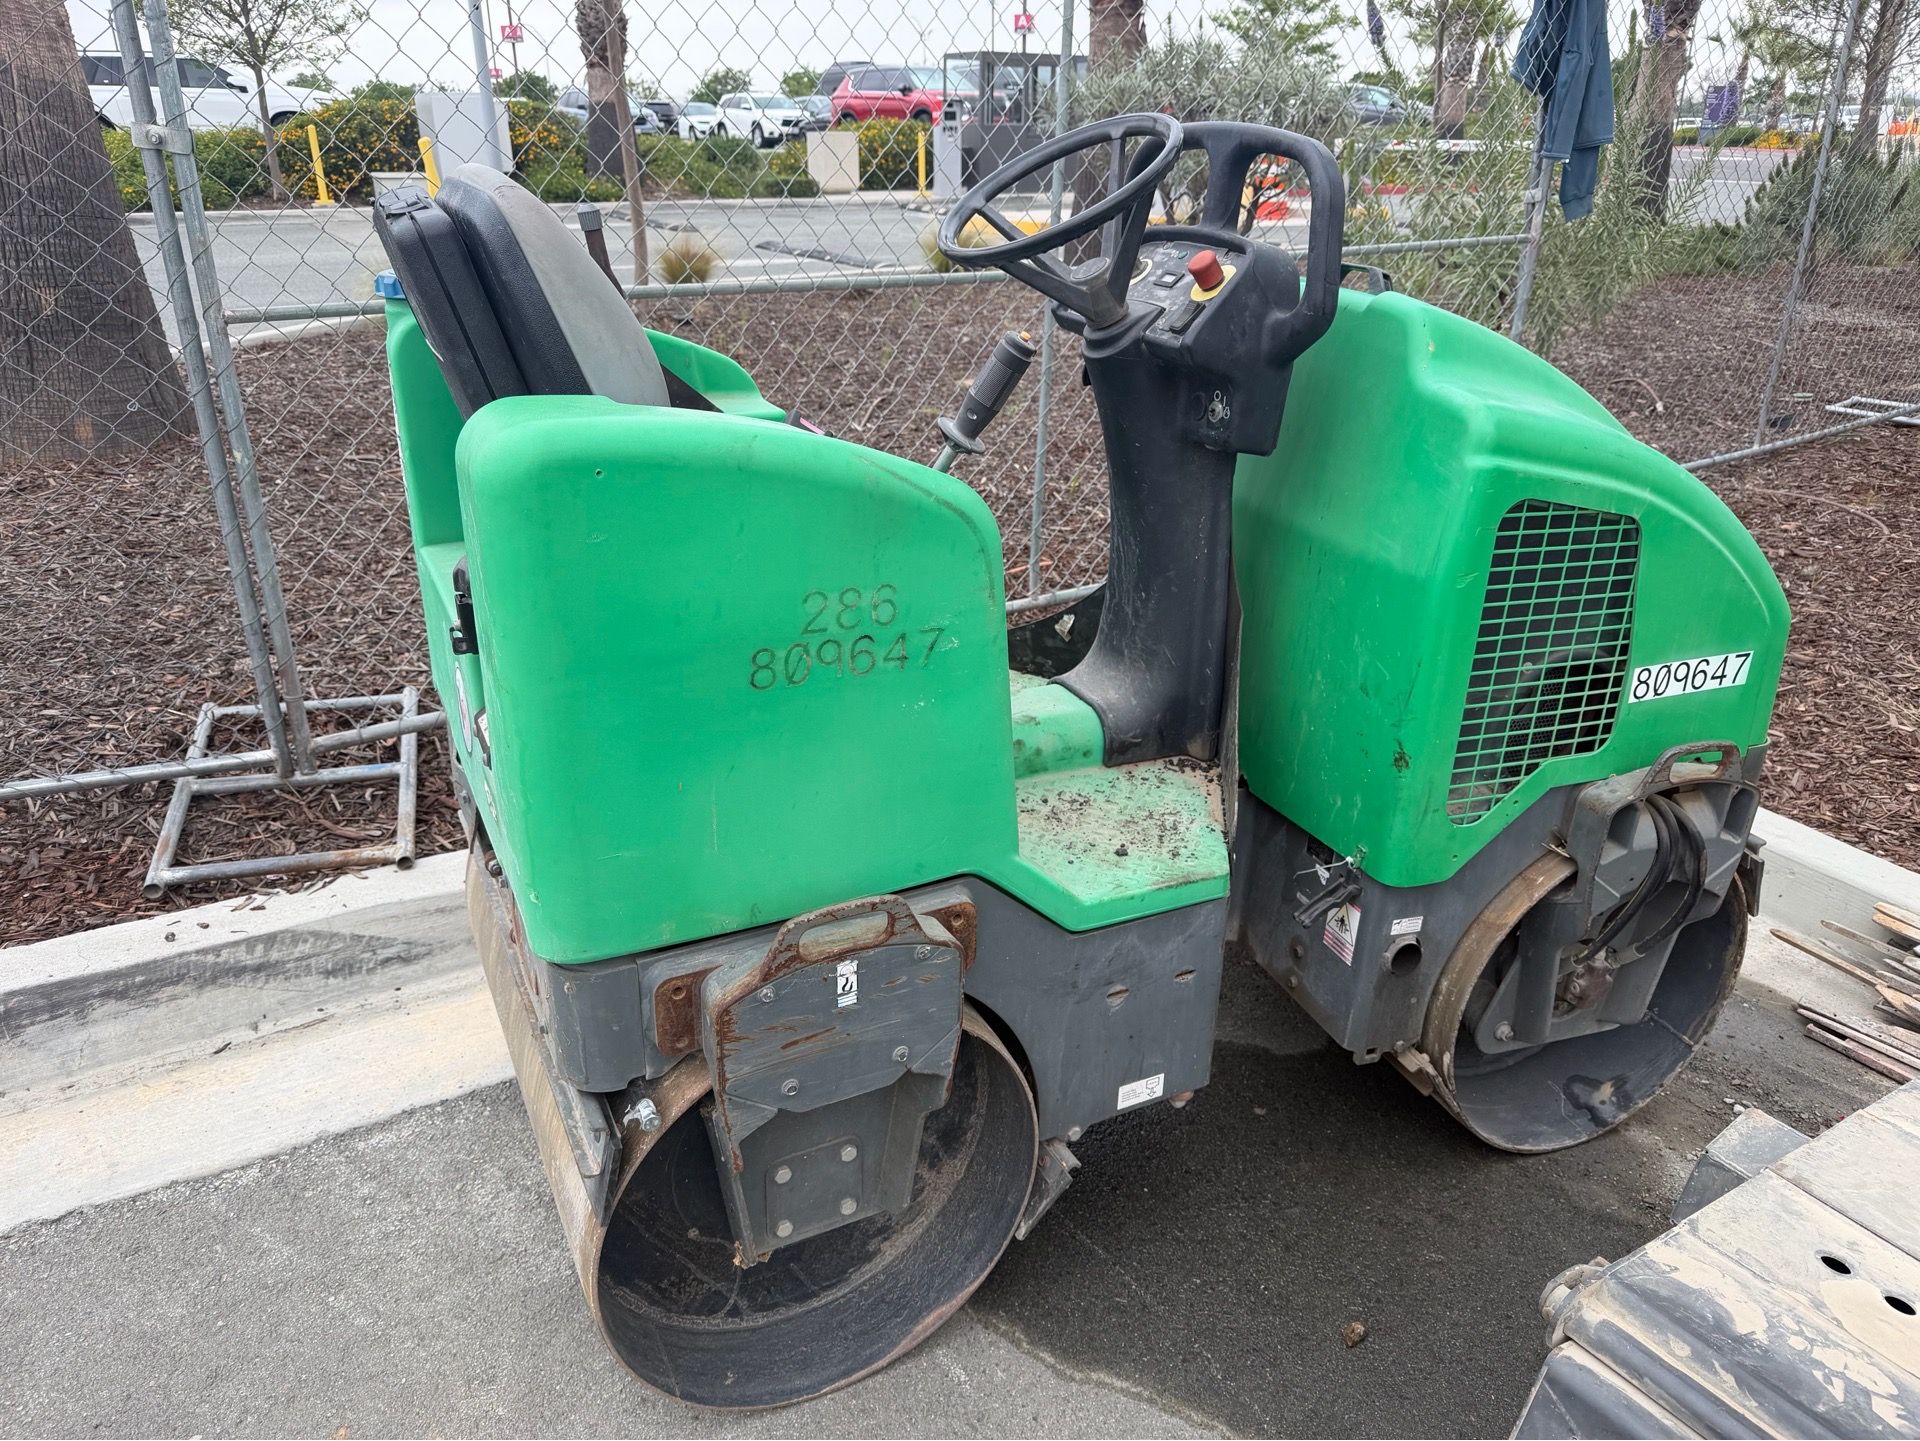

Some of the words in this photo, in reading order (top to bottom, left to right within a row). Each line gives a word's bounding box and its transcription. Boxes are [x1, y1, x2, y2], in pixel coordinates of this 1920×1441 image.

[800, 583, 897, 636] 286
[749, 626, 946, 691] 809647
[1633, 652, 1751, 701] 809647
